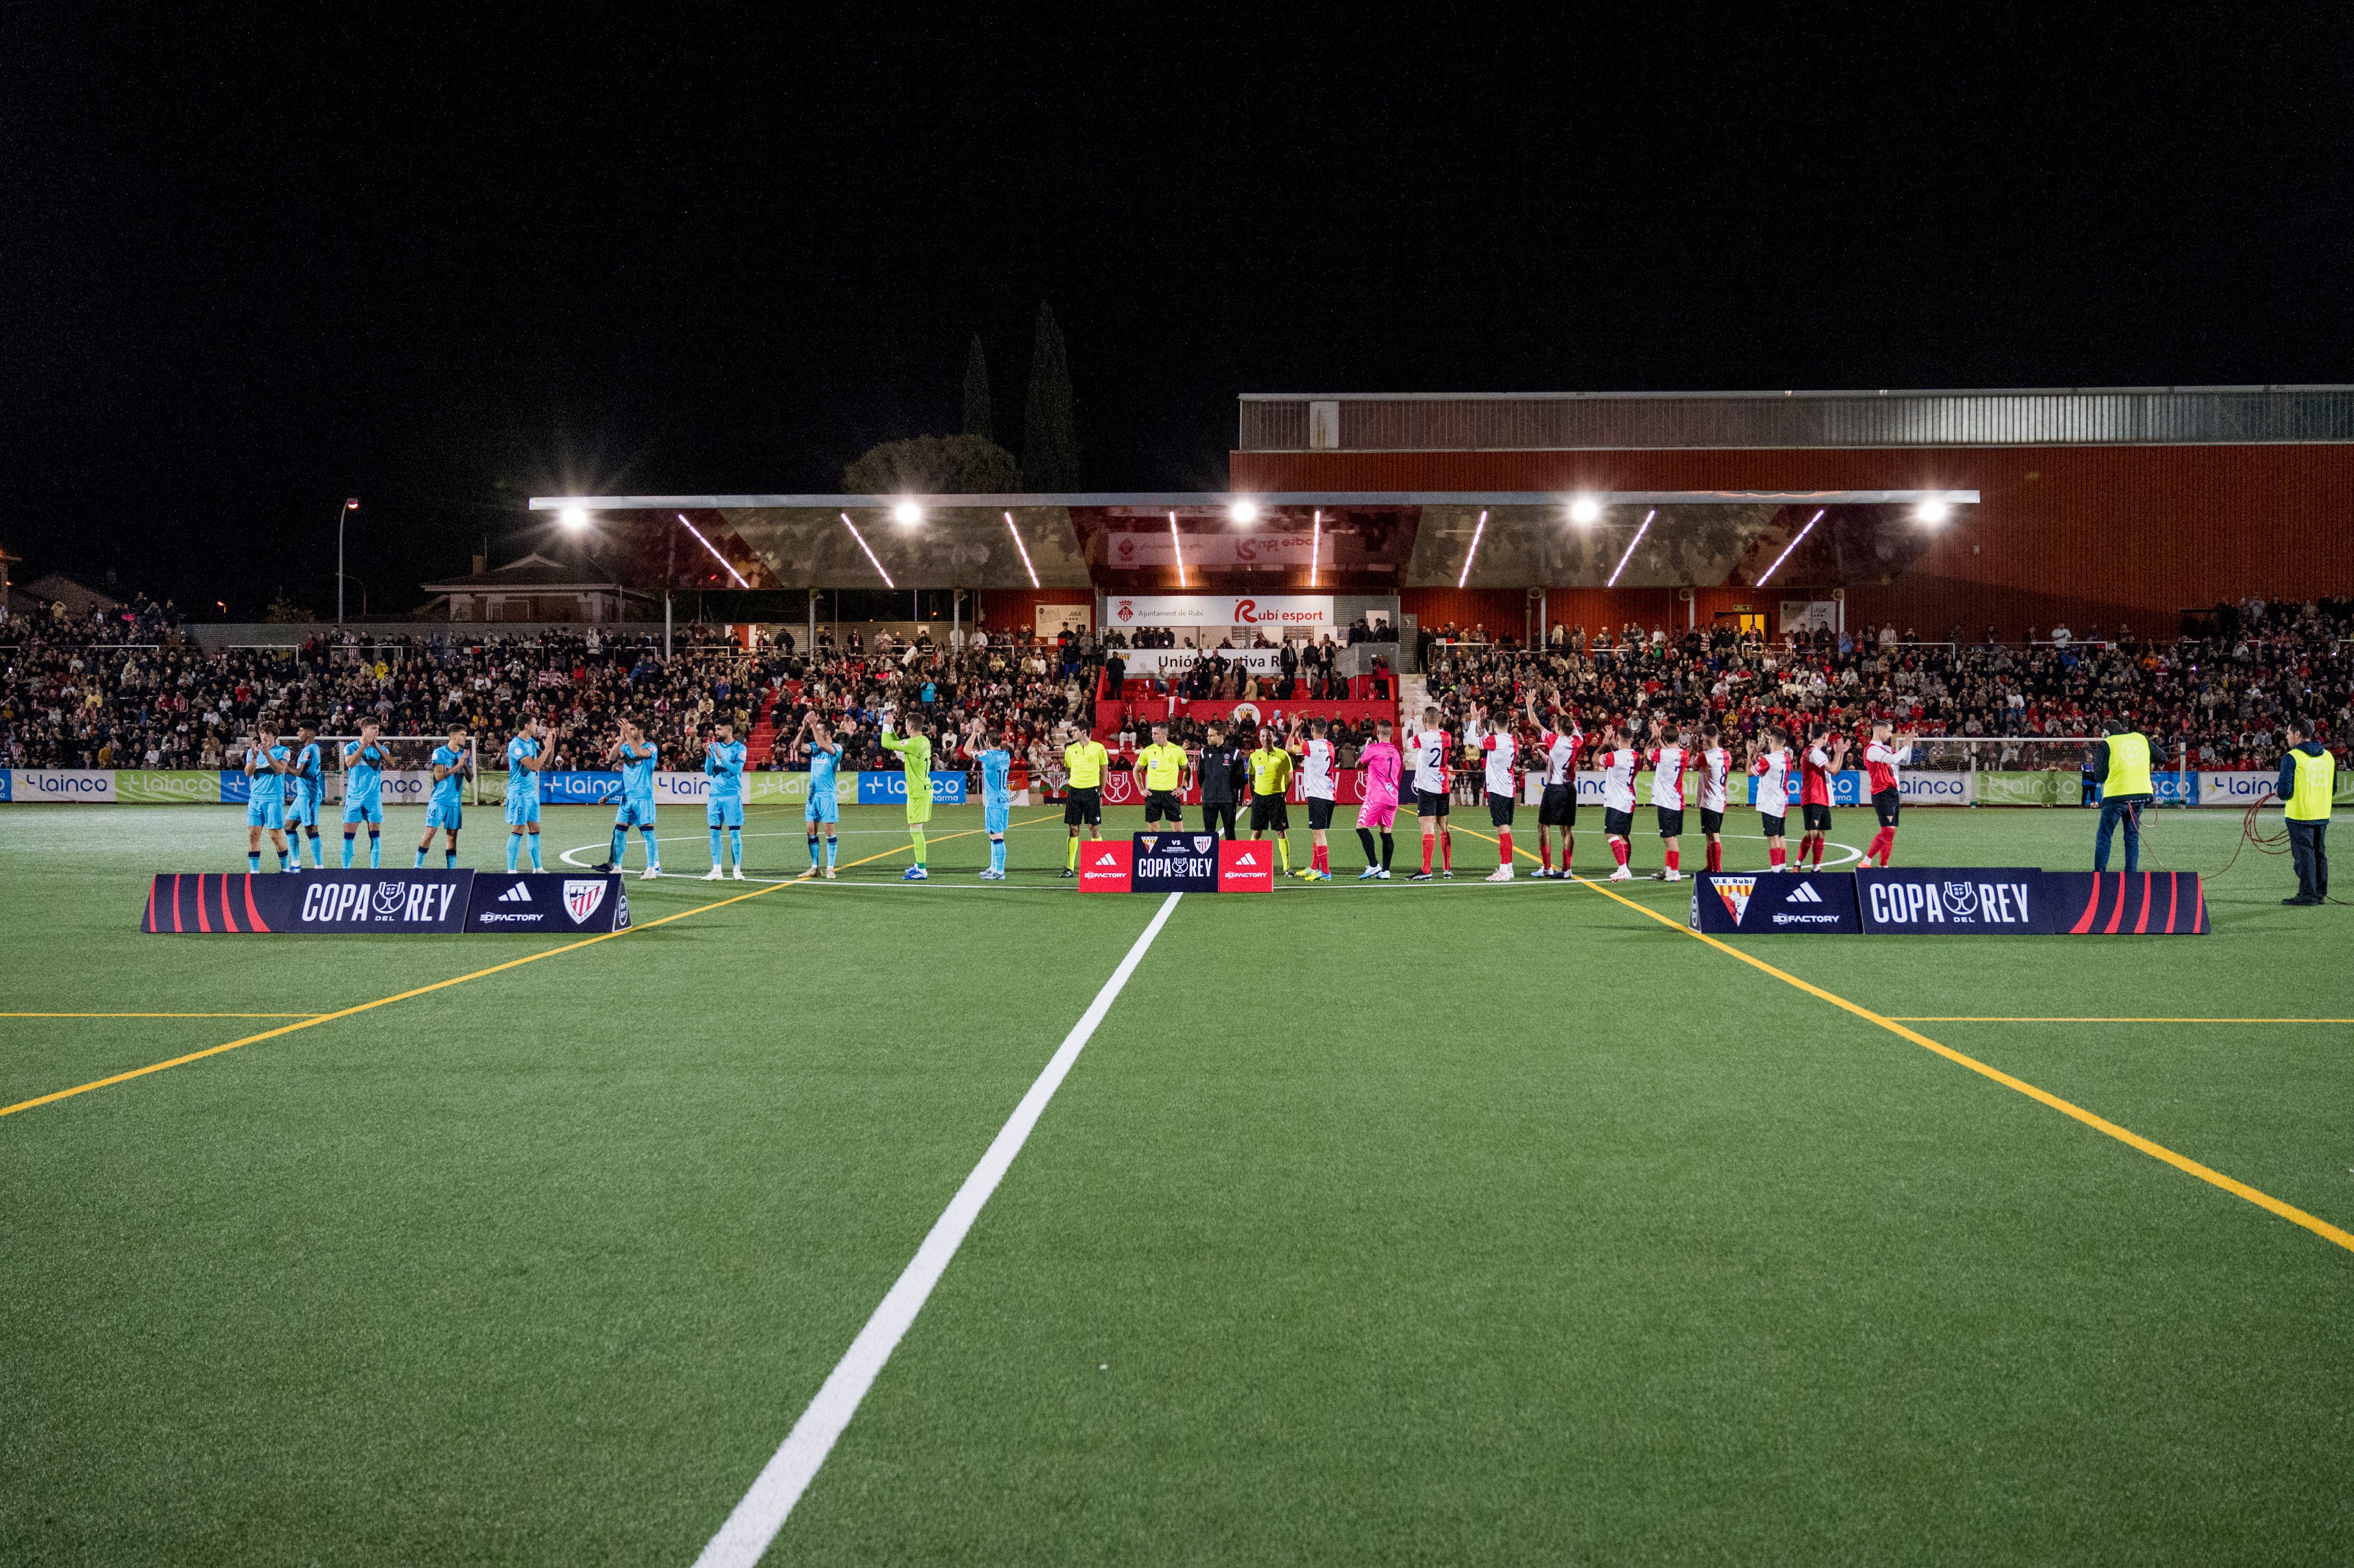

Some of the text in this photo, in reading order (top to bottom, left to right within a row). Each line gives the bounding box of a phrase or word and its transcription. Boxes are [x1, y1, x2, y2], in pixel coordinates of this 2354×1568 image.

[1235, 599, 1323, 623] Rubí esport
[1325, 755, 1332, 776] 2
[1429, 747, 1450, 767] 20
[1387, 757, 1393, 778] 1
[1674, 766, 1683, 786] 7
[1720, 765, 1727, 785] 8
[40, 775, 108, 792] lainco
[143, 774, 213, 792] lainco
[1900, 776, 1964, 794] ainco
[427, 809, 436, 817] 24
[517, 806, 522, 816] 6
[1138, 858, 1171, 877] COPA
[1189, 858, 1212, 877] REY
[302, 883, 371, 921] COPA
[403, 884, 457, 921] REY
[1870, 883, 1945, 923] COPA
[1979, 884, 2029, 922] REY
